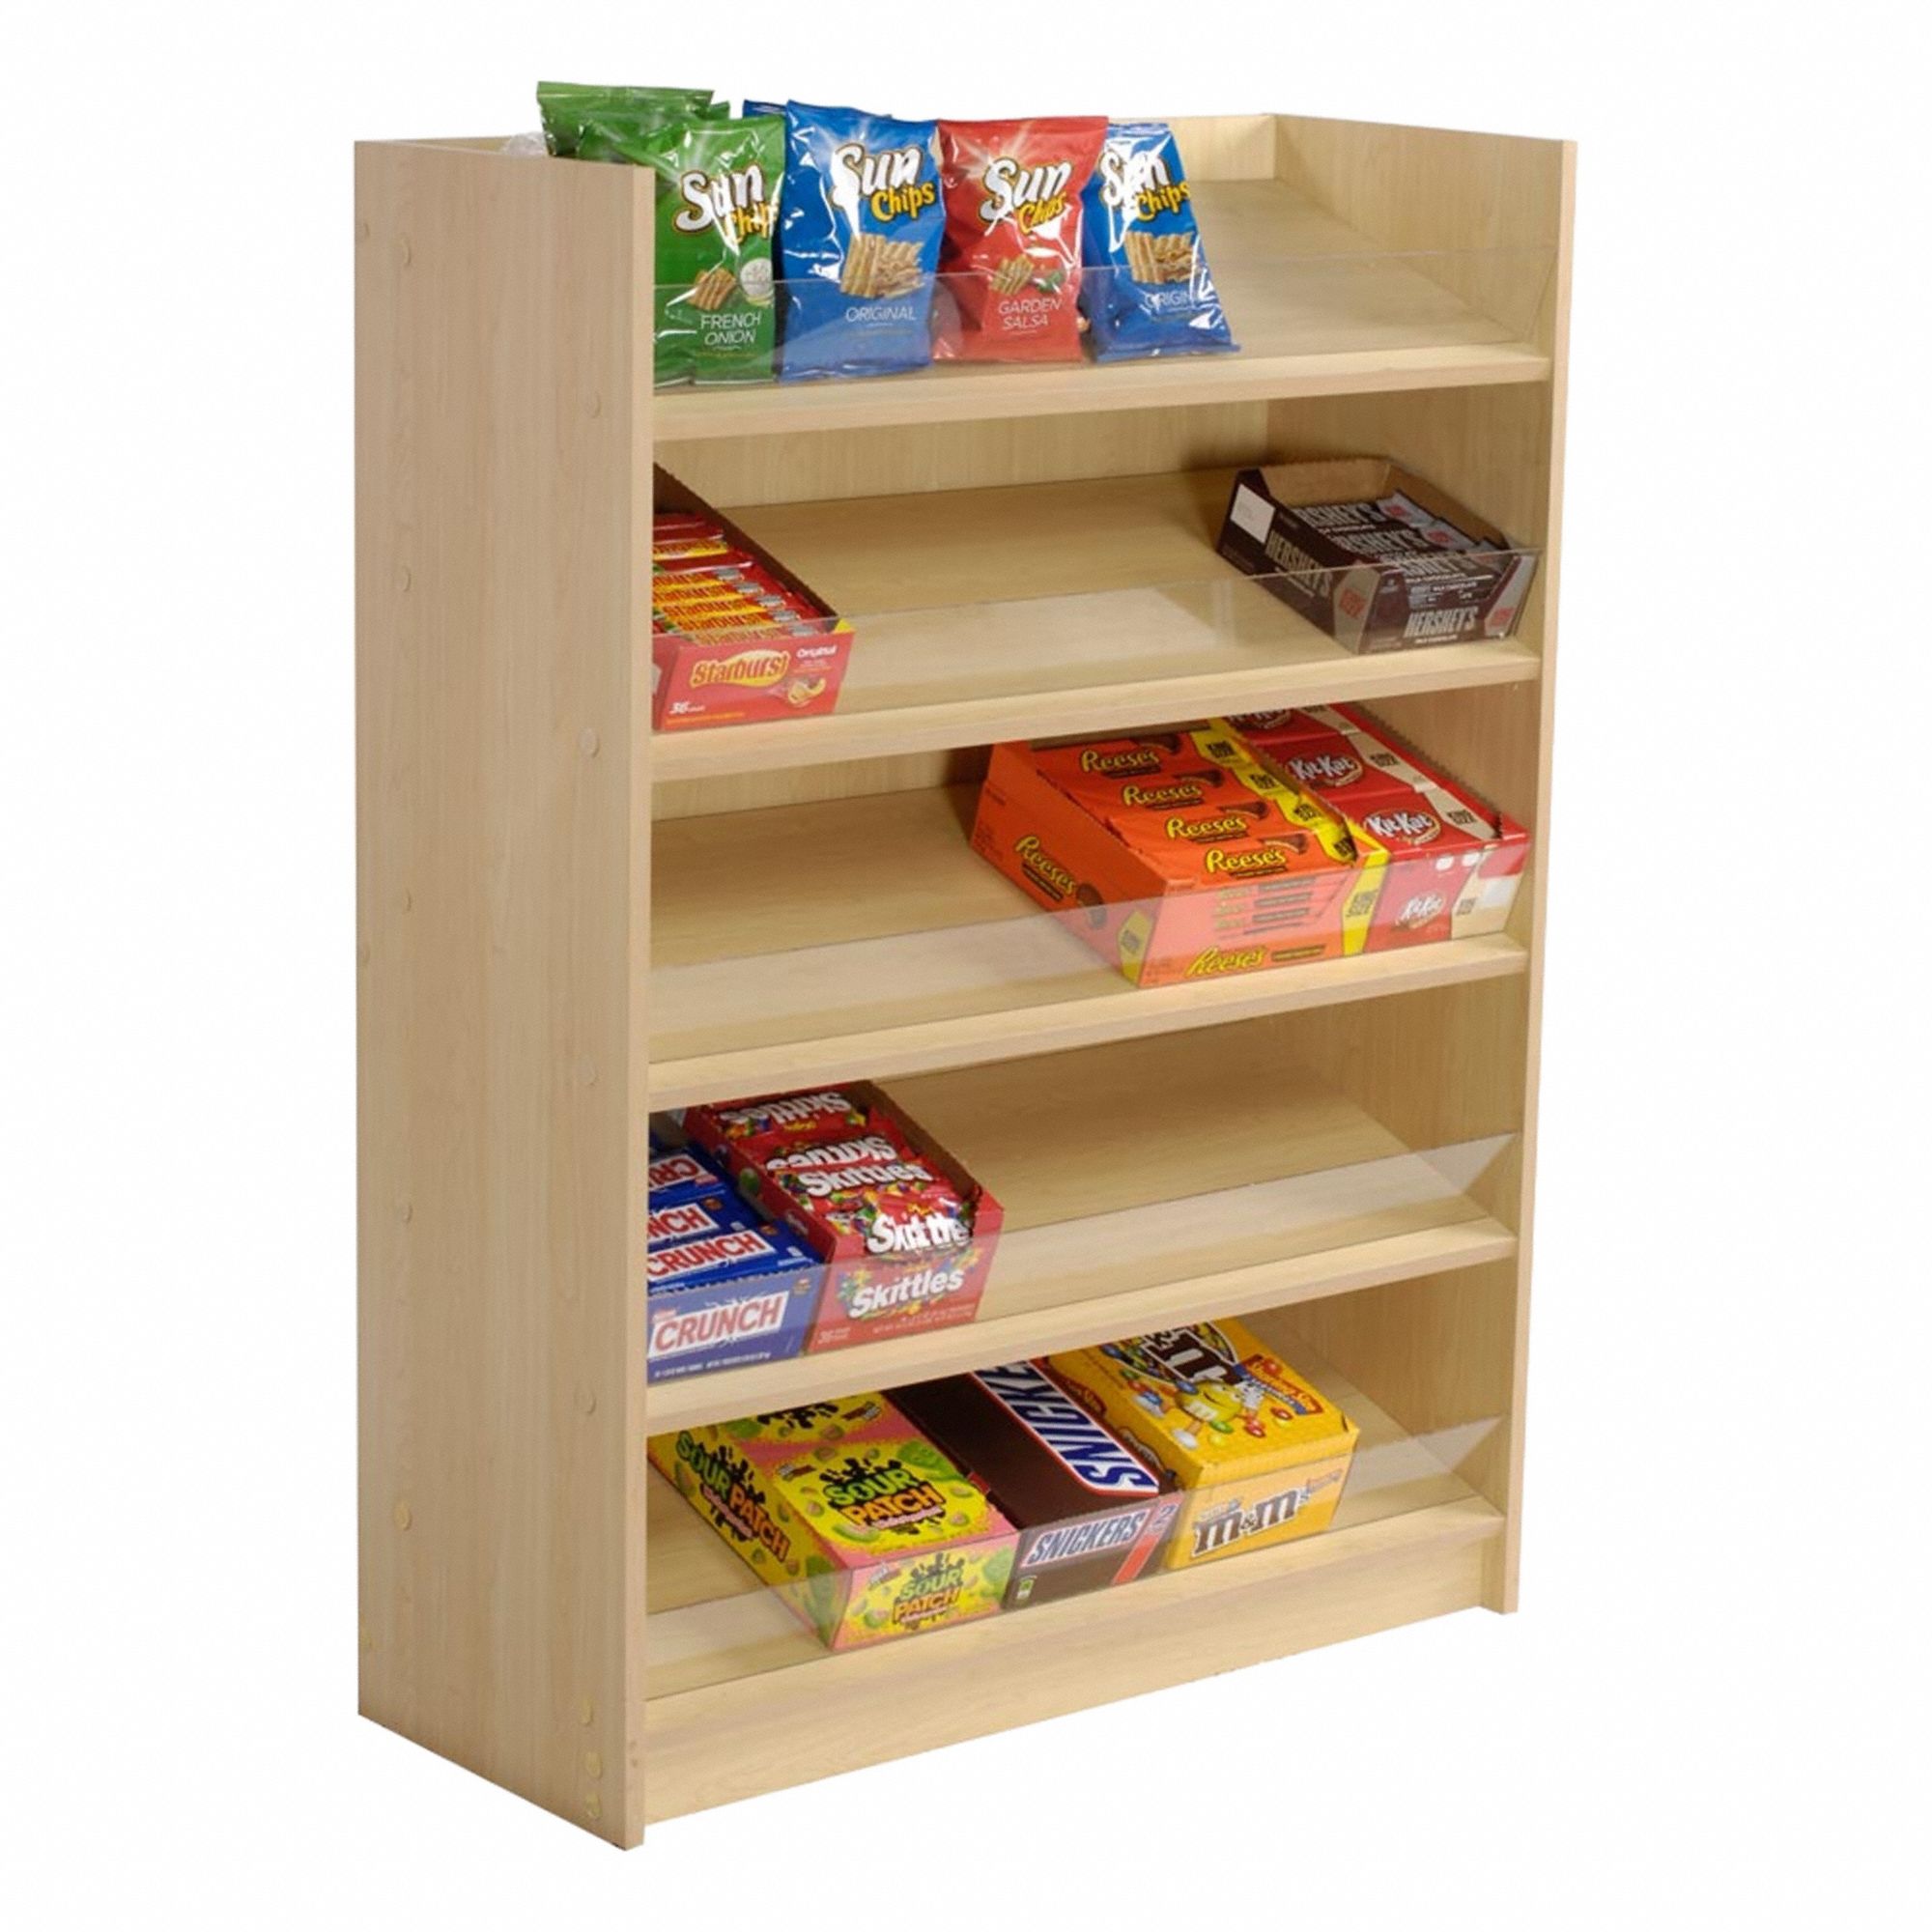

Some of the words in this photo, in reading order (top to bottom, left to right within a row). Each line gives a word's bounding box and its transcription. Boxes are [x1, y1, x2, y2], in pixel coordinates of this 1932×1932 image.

[831, 142, 922, 208] Sun
[980, 157, 1072, 222] Sun
[872, 182, 935, 221] Chips
[1135, 181, 1191, 221] Chips
[700, 312, 762, 329] FRENCH
[845, 305, 917, 323] ORIGINAL
[999, 298, 1062, 315] GARDEN
[1003, 315, 1048, 329] SALSA
[704, 328, 756, 346] ONION
[1404, 606, 1479, 638] HERSHEY'S
[691, 652, 790, 687] Starburst
[1206, 848, 1287, 873] Reese's
[648, 1231, 768, 1277] CRUNCH
[849, 1268, 964, 1319] Skittles
[655, 1295, 783, 1350] CRUNCH
[676, 1431, 731, 1501] SOUR
[824, 1468, 919, 1506] SOUR
[840, 1485, 945, 1526] PATCH
[729, 1484, 790, 1562] PATCH
[1028, 1512, 1147, 1564] SNICKERS
[900, 1568, 963, 1602] SOUR
[894, 1587, 960, 1623] PATCH
